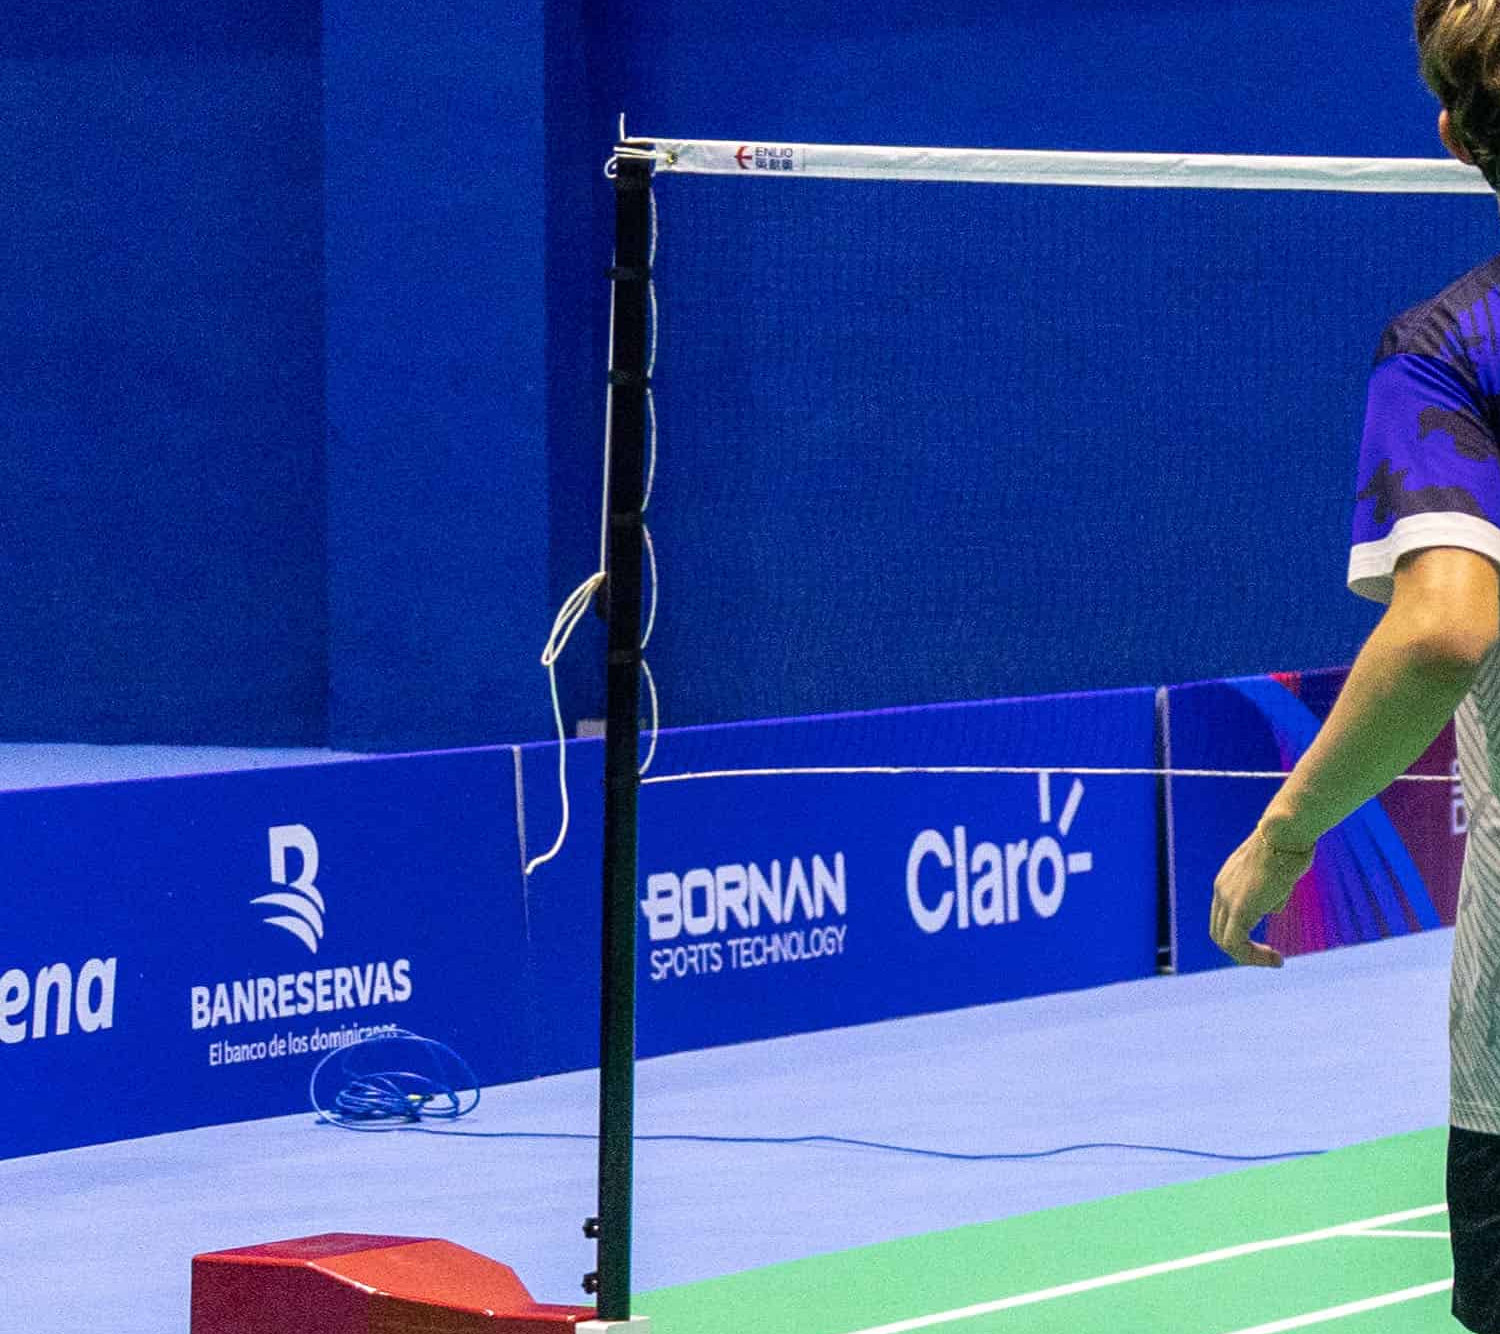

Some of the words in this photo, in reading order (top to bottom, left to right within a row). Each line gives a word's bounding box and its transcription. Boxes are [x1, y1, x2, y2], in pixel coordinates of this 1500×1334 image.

[641, 851, 847, 941] BORNAN
[907, 826, 1066, 934] Claro
[650, 943, 723, 981] SPORTS
[728, 925, 847, 970] TECHNOLOGY
[191, 959, 412, 1030] BANRESERVAS
[209, 1041, 223, 1066] El
[224, 1040, 267, 1065] banco
[269, 1033, 288, 1058] de
[288, 1032, 309, 1054] los
